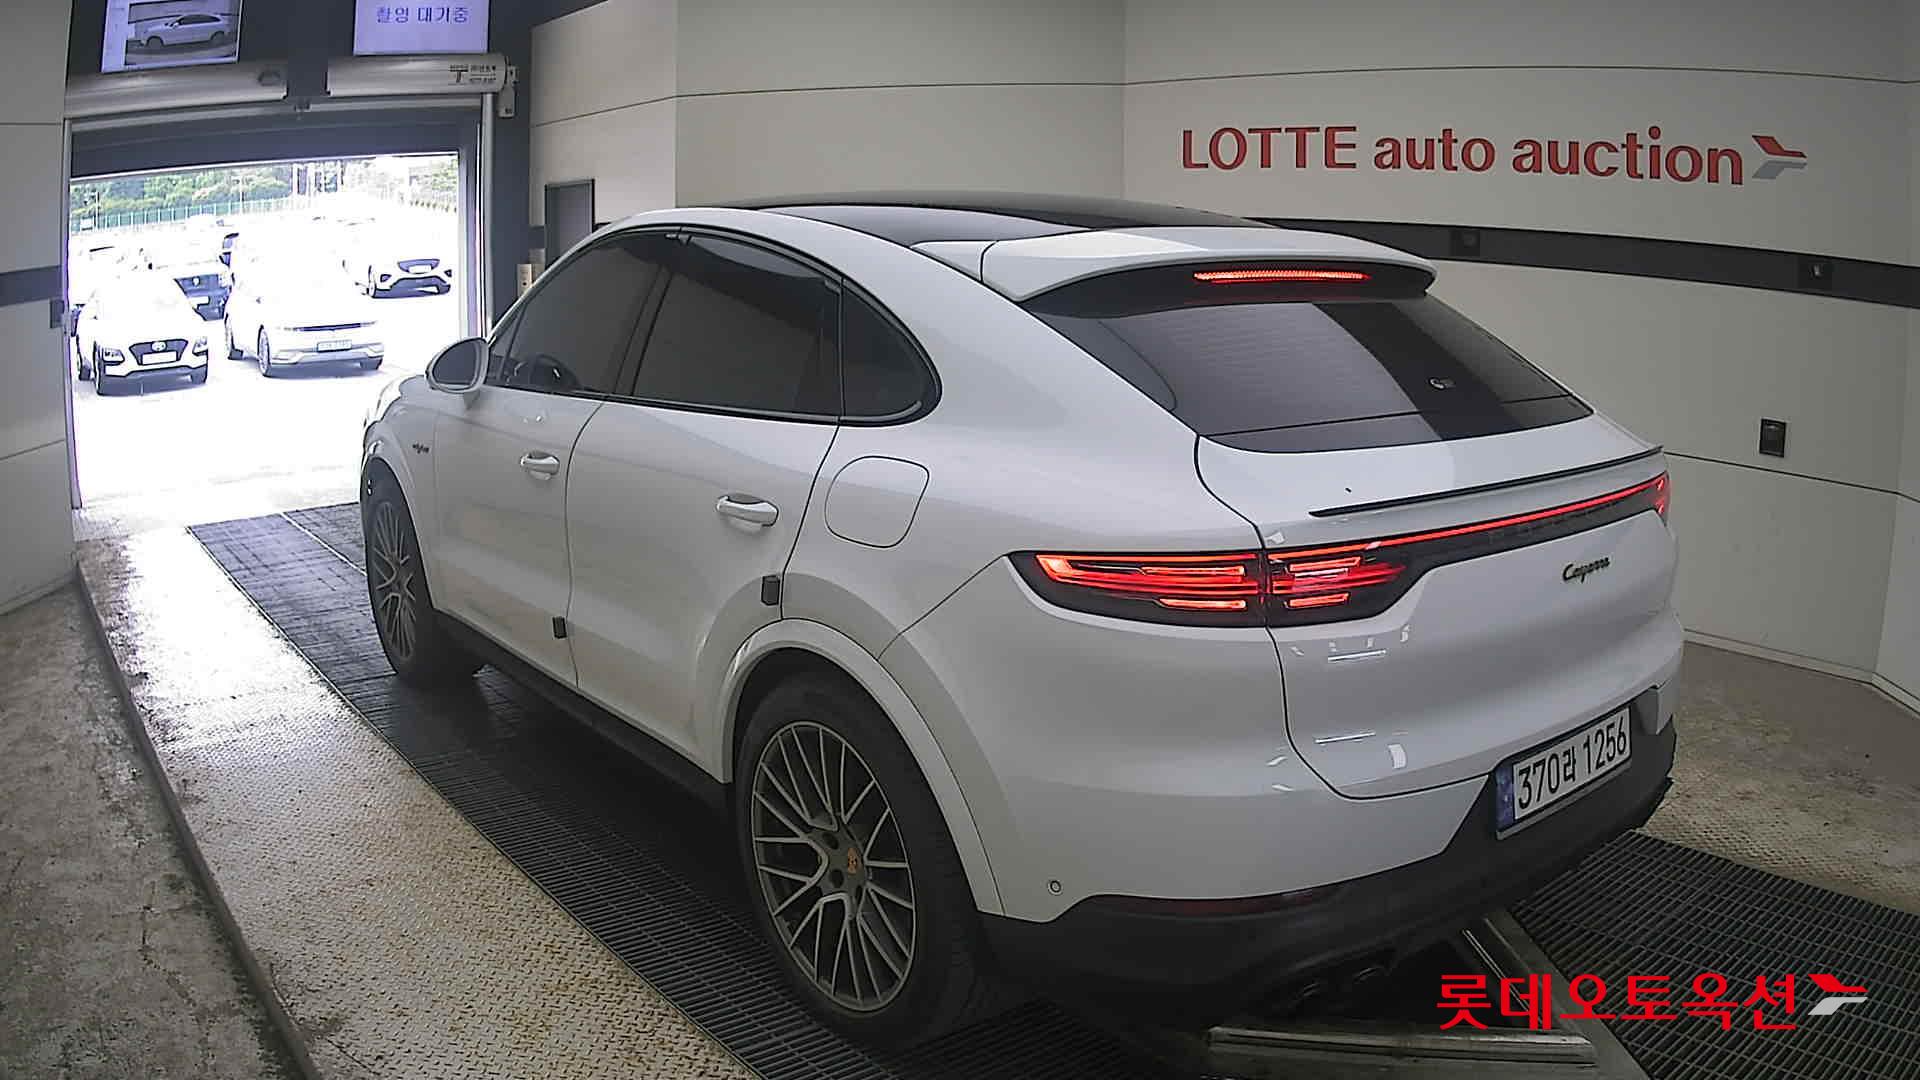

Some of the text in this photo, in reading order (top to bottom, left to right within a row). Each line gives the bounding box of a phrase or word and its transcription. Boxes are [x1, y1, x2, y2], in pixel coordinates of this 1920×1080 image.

[417, 7, 470, 23] 대기중
[1181, 125, 1744, 186] LOTTE auto auction
[1518, 716, 1627, 810] 370라 1256
